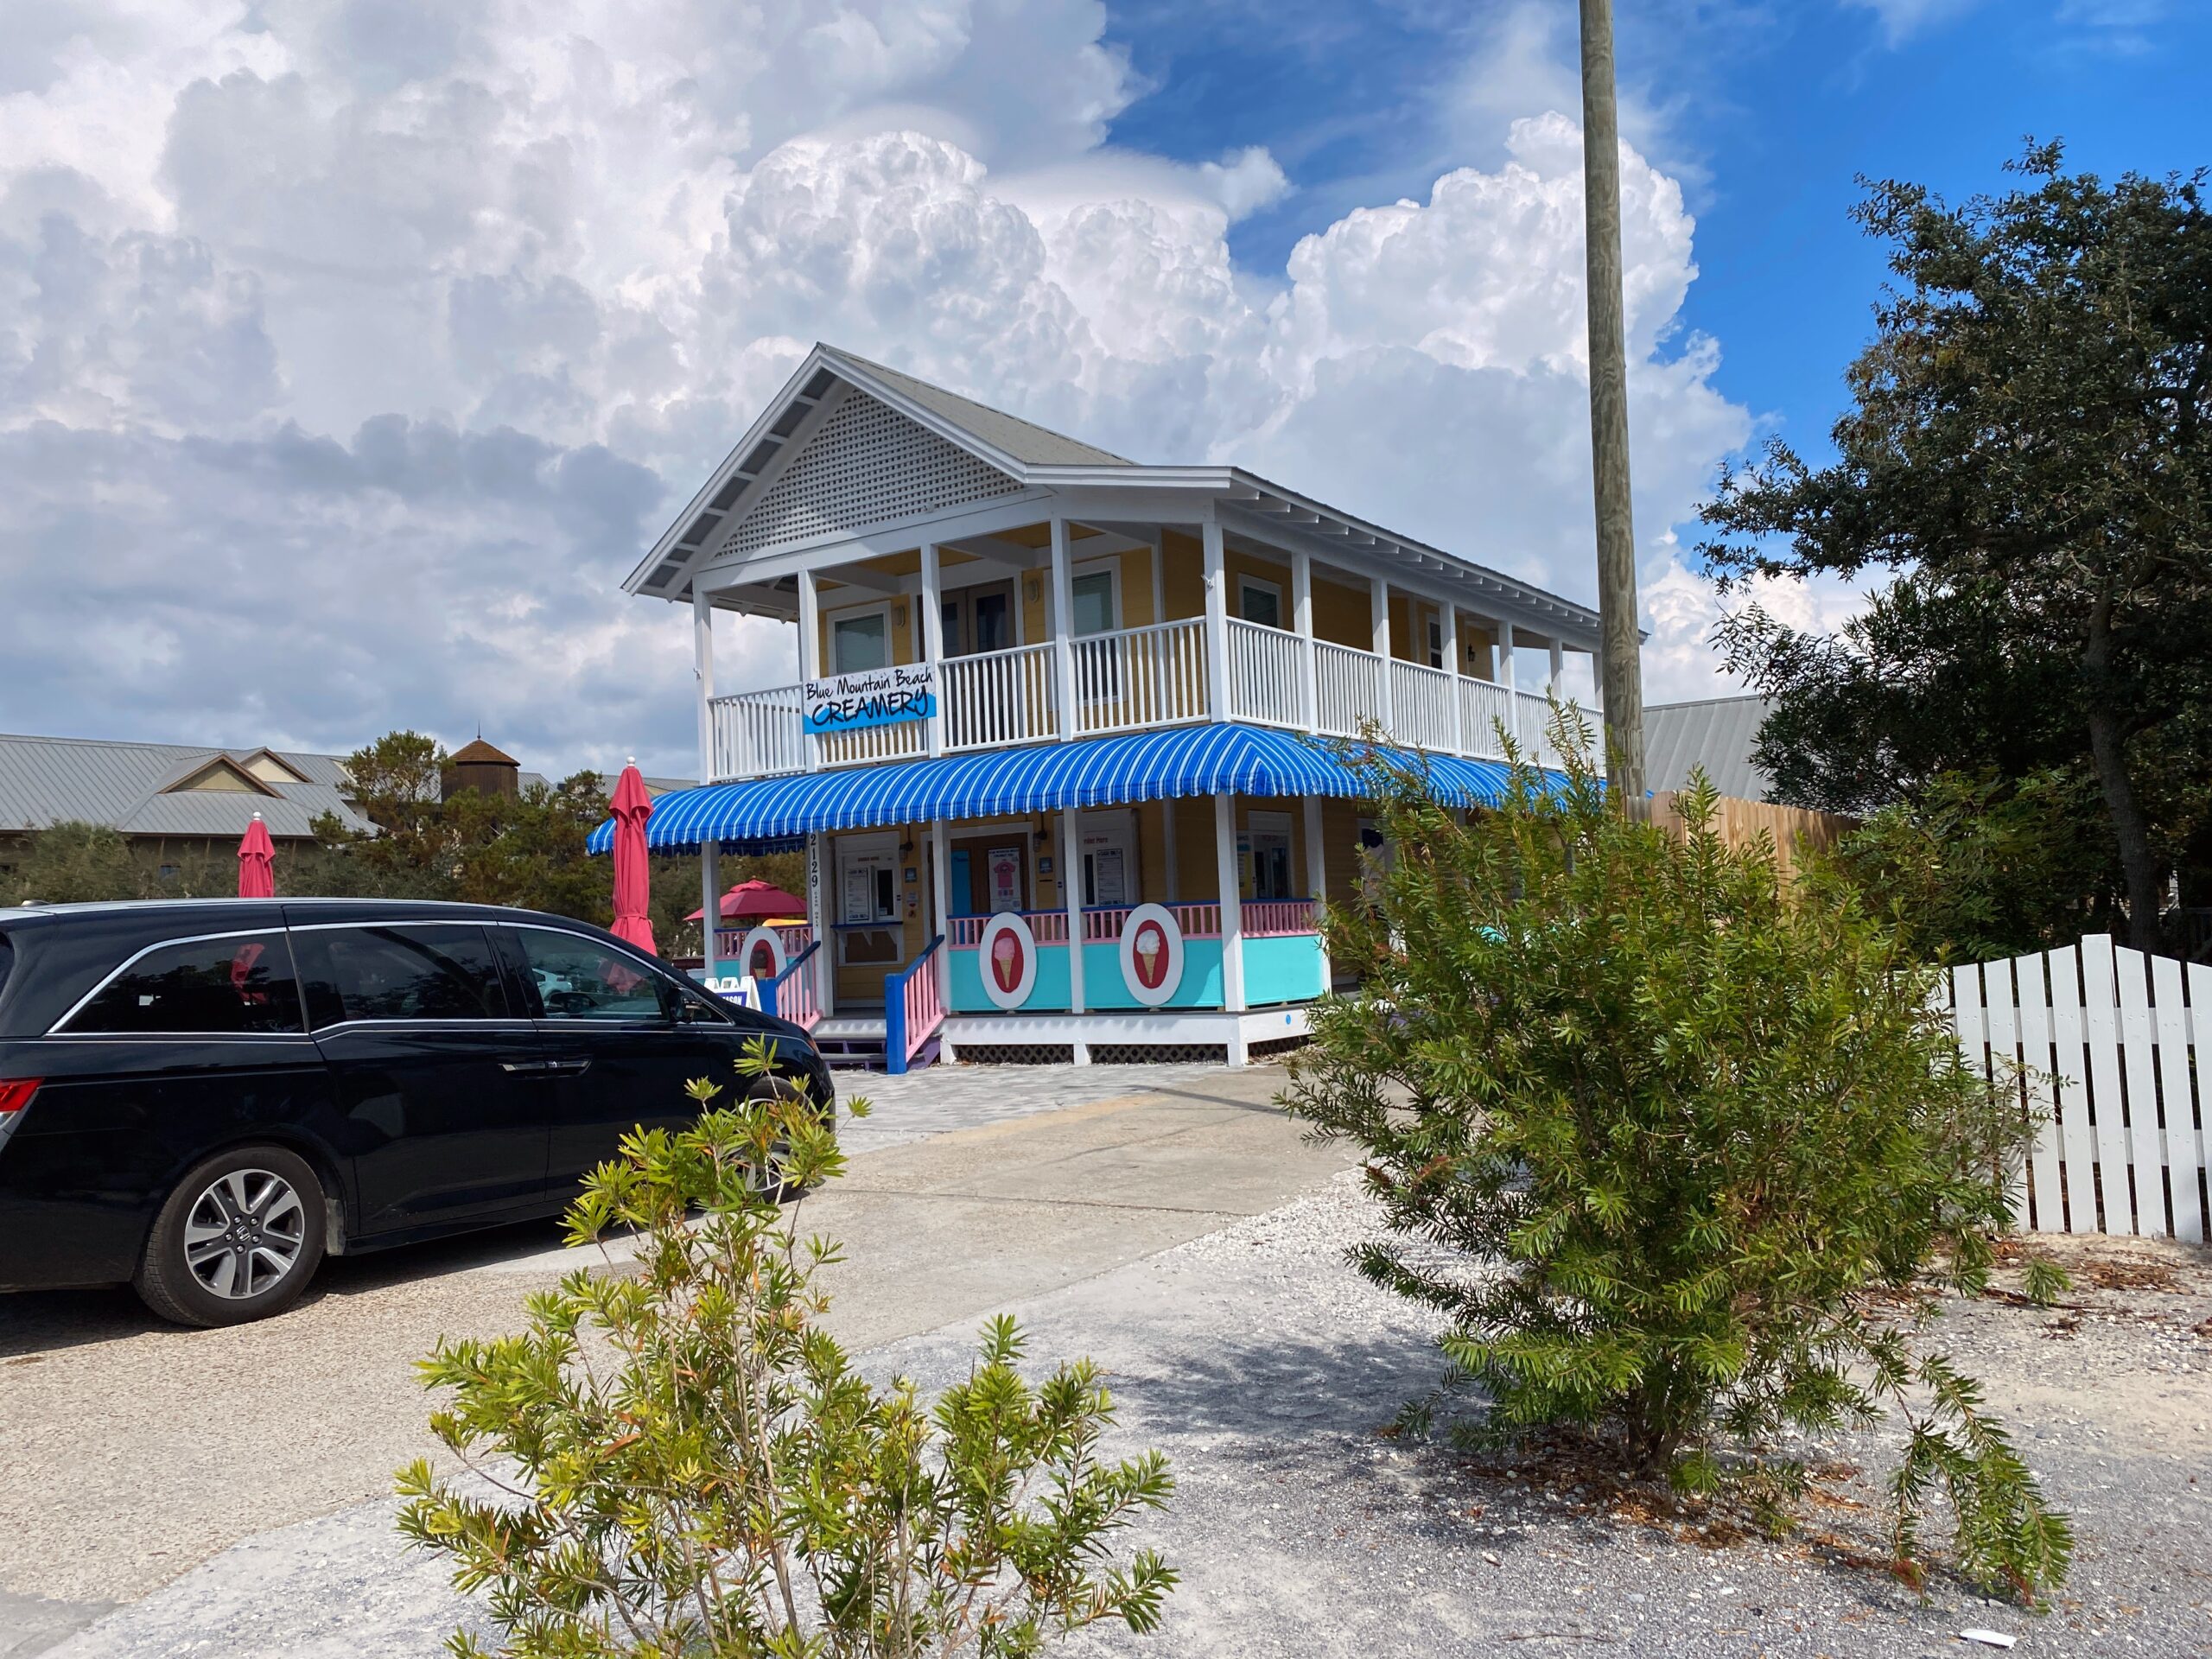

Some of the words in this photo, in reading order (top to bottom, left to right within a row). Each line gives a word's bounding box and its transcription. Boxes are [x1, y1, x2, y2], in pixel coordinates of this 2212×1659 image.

[805, 682, 834, 701] Blue
[836, 676, 891, 696] Mountain
[894, 665, 933, 686] Beach
[811, 685, 928, 726] CREAMERY
[810, 833, 818, 887] 2129
